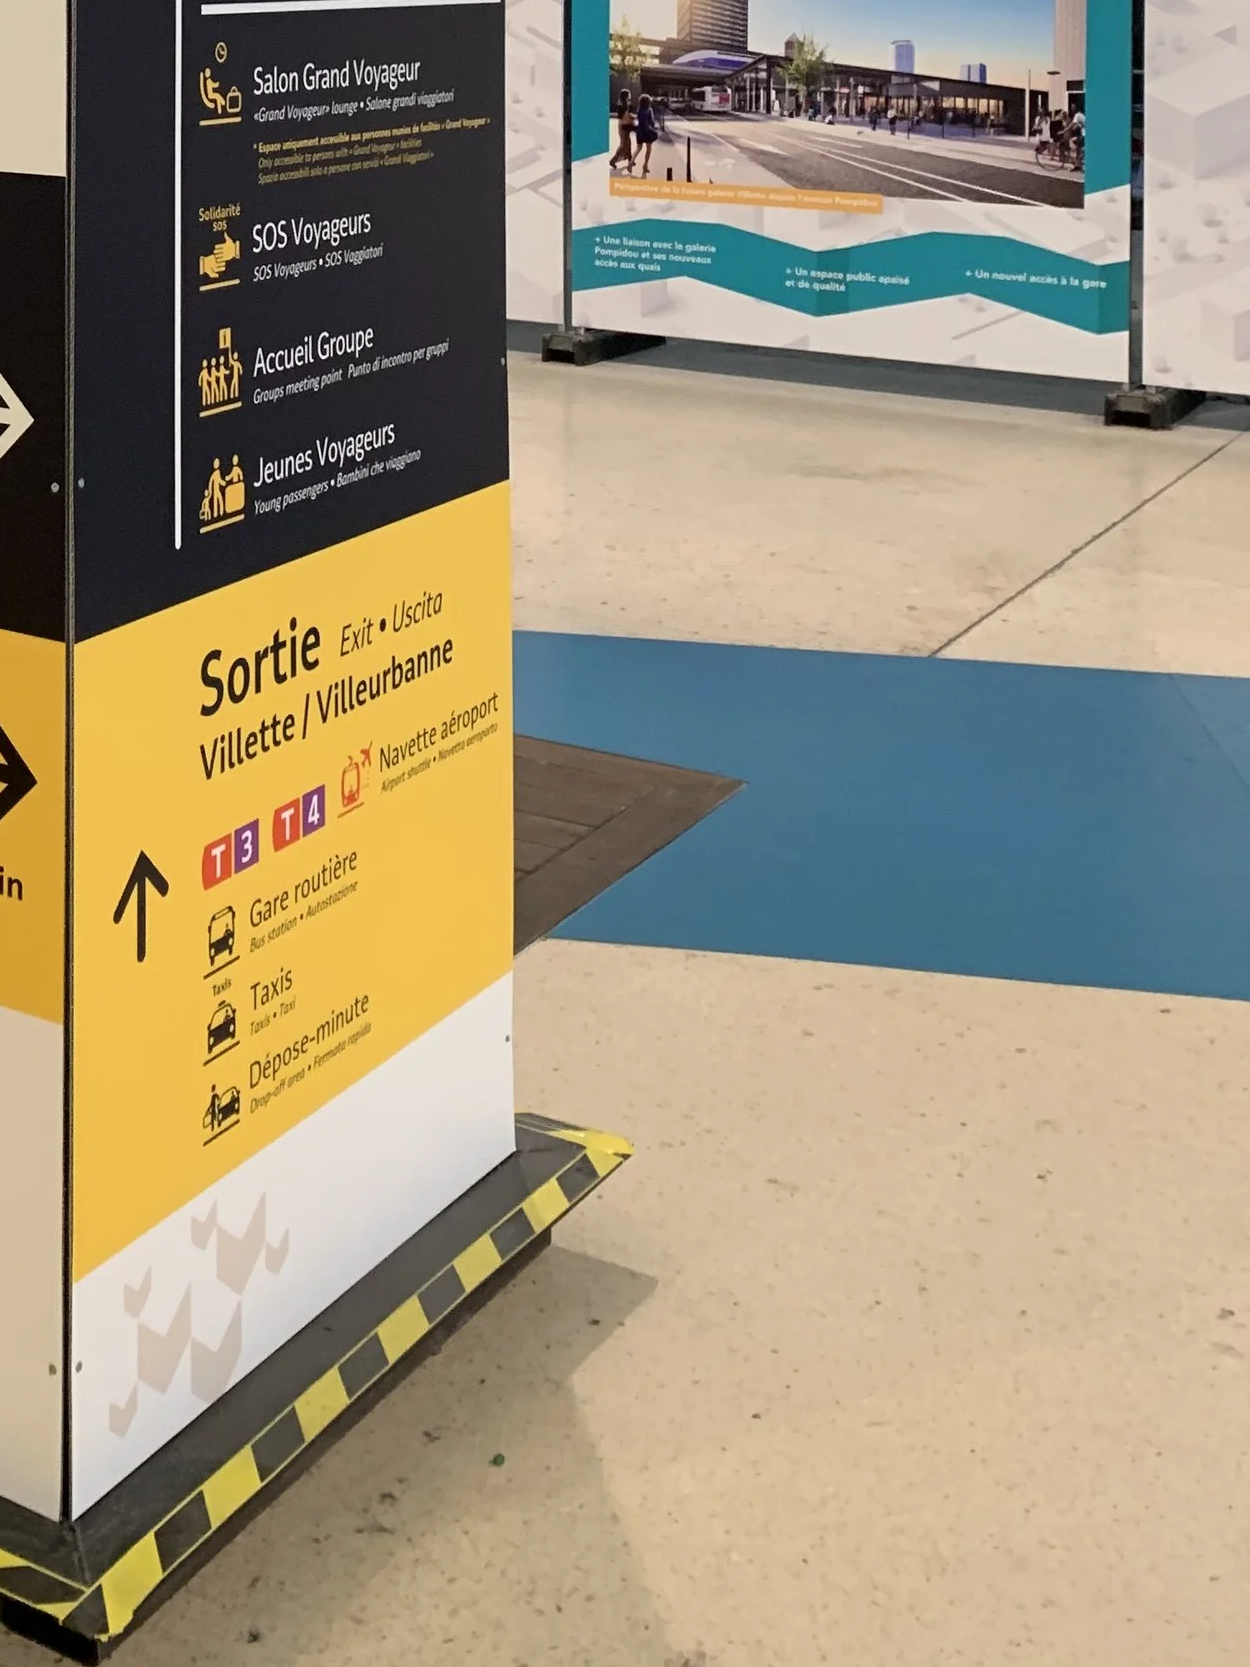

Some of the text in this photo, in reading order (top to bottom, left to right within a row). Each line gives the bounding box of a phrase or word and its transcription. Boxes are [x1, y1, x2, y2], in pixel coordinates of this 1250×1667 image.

[254, 58, 421, 96] Salon Grand Voyageur
[199, 203, 241, 222] Solidarité
[252, 213, 372, 253] SOS Voyageurs
[594, 247, 639, 260] Pompidou
[623, 237, 716, 255] liaison galerie
[638, 262, 661, 272] quais
[846, 271, 876, 283] public
[975, 269, 1106, 289] Un nouvel gare
[253, 327, 374, 378] Accueil Groupe
[253, 423, 396, 488] Jeunes Voyageurs
[200, 591, 443, 717] Sortie Exit Uscita
[200, 638, 454, 781] Villette Villeurbanne
[380, 691, 498, 773] Navette aéroport
[250, 850, 357, 928] Gare routière
[250, 966, 293, 1011] Taxis
[250, 993, 370, 1089] Dépose-minute
